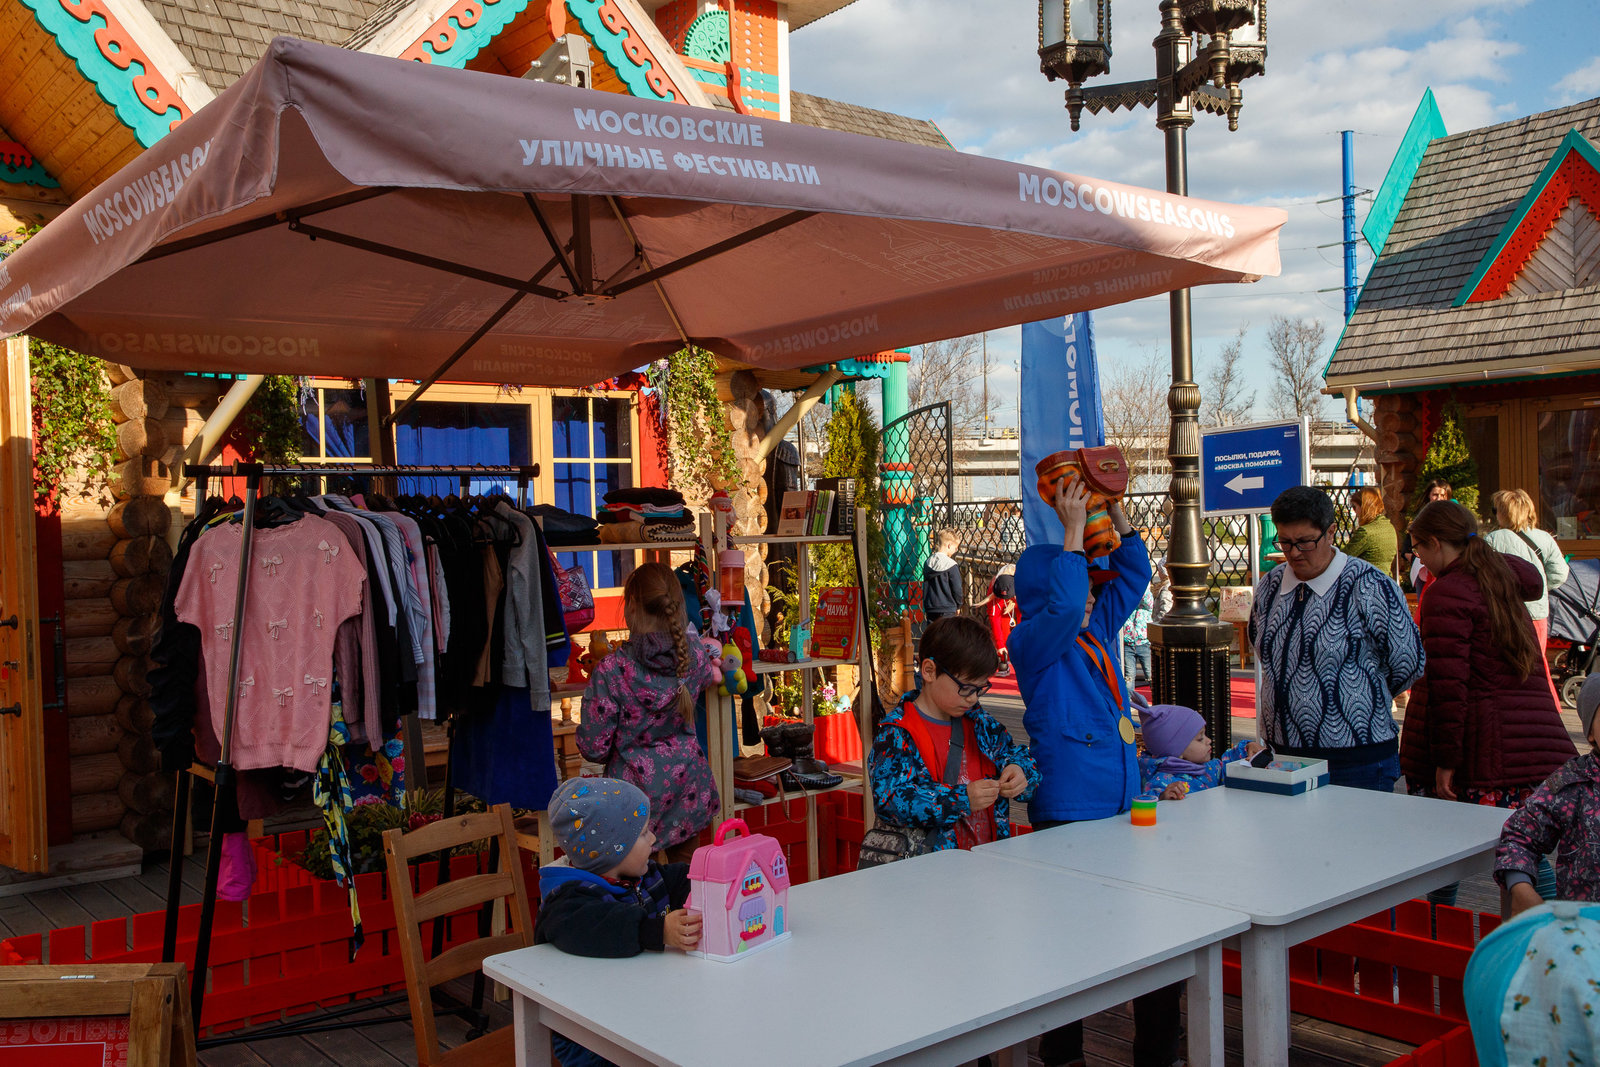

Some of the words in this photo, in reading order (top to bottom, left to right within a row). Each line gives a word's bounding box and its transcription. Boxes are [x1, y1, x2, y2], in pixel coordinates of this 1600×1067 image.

[573, 107, 764, 147] МОСКОВСКИЕ
[518, 138, 668, 171] УЛИЧНЫЕ
[672, 152, 821, 185] ФЕСТИВАЛИ
[1018, 172, 1235, 239] MOSCOWSEASONS
[1215, 452, 1247, 461] ПОСЫЛКИ,
[1248, 450, 1280, 459] ПОДАРКИ,
[826, 604, 849, 616] НАУКА
